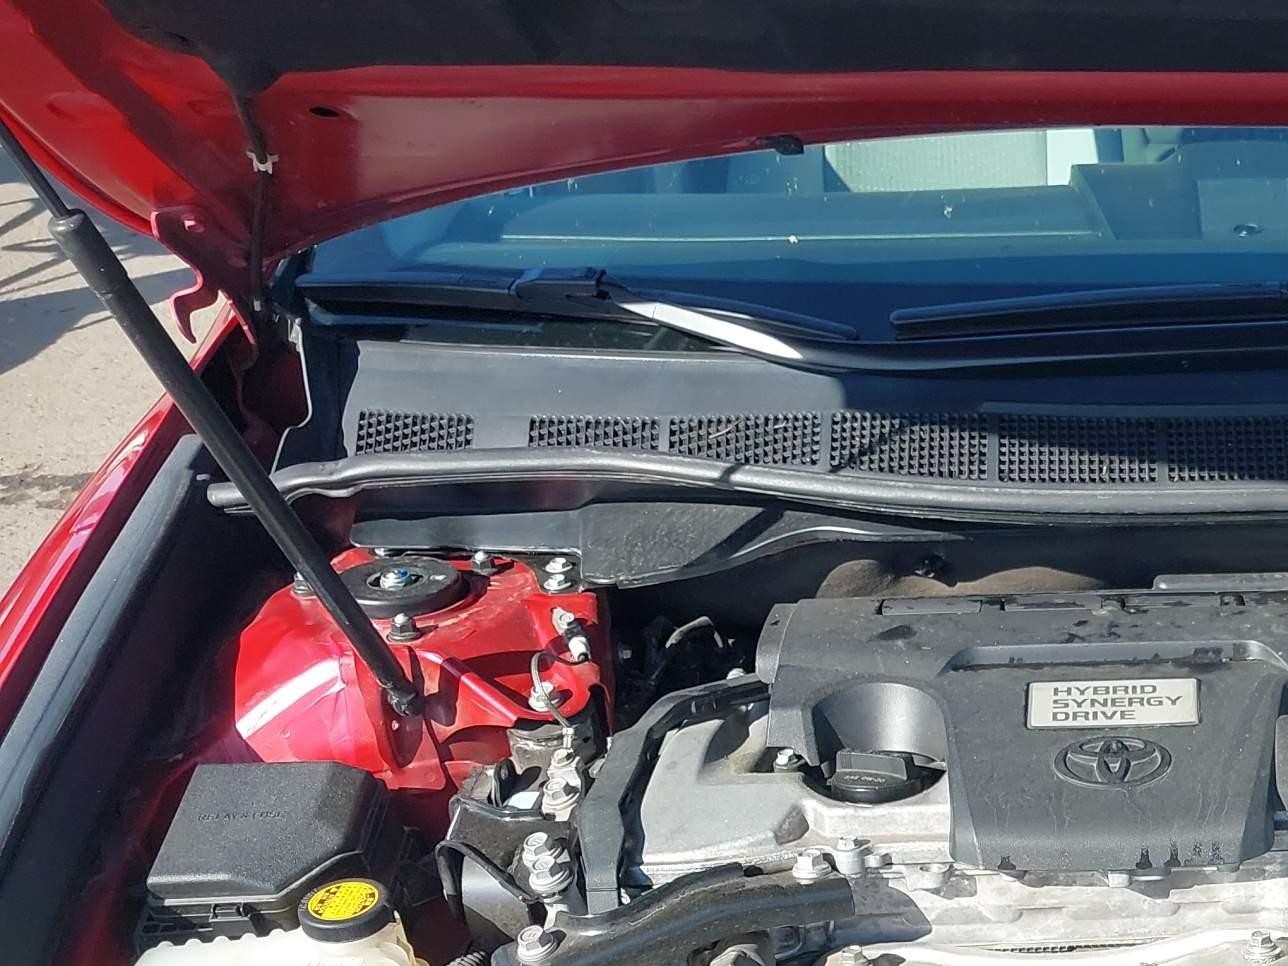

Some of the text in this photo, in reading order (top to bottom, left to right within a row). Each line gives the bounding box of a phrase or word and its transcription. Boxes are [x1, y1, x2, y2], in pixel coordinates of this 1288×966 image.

[1053, 684, 1157, 697] HYBRID
[1052, 696, 1183, 709] SYNERGY
[1051, 710, 1136, 722] DRIVE
